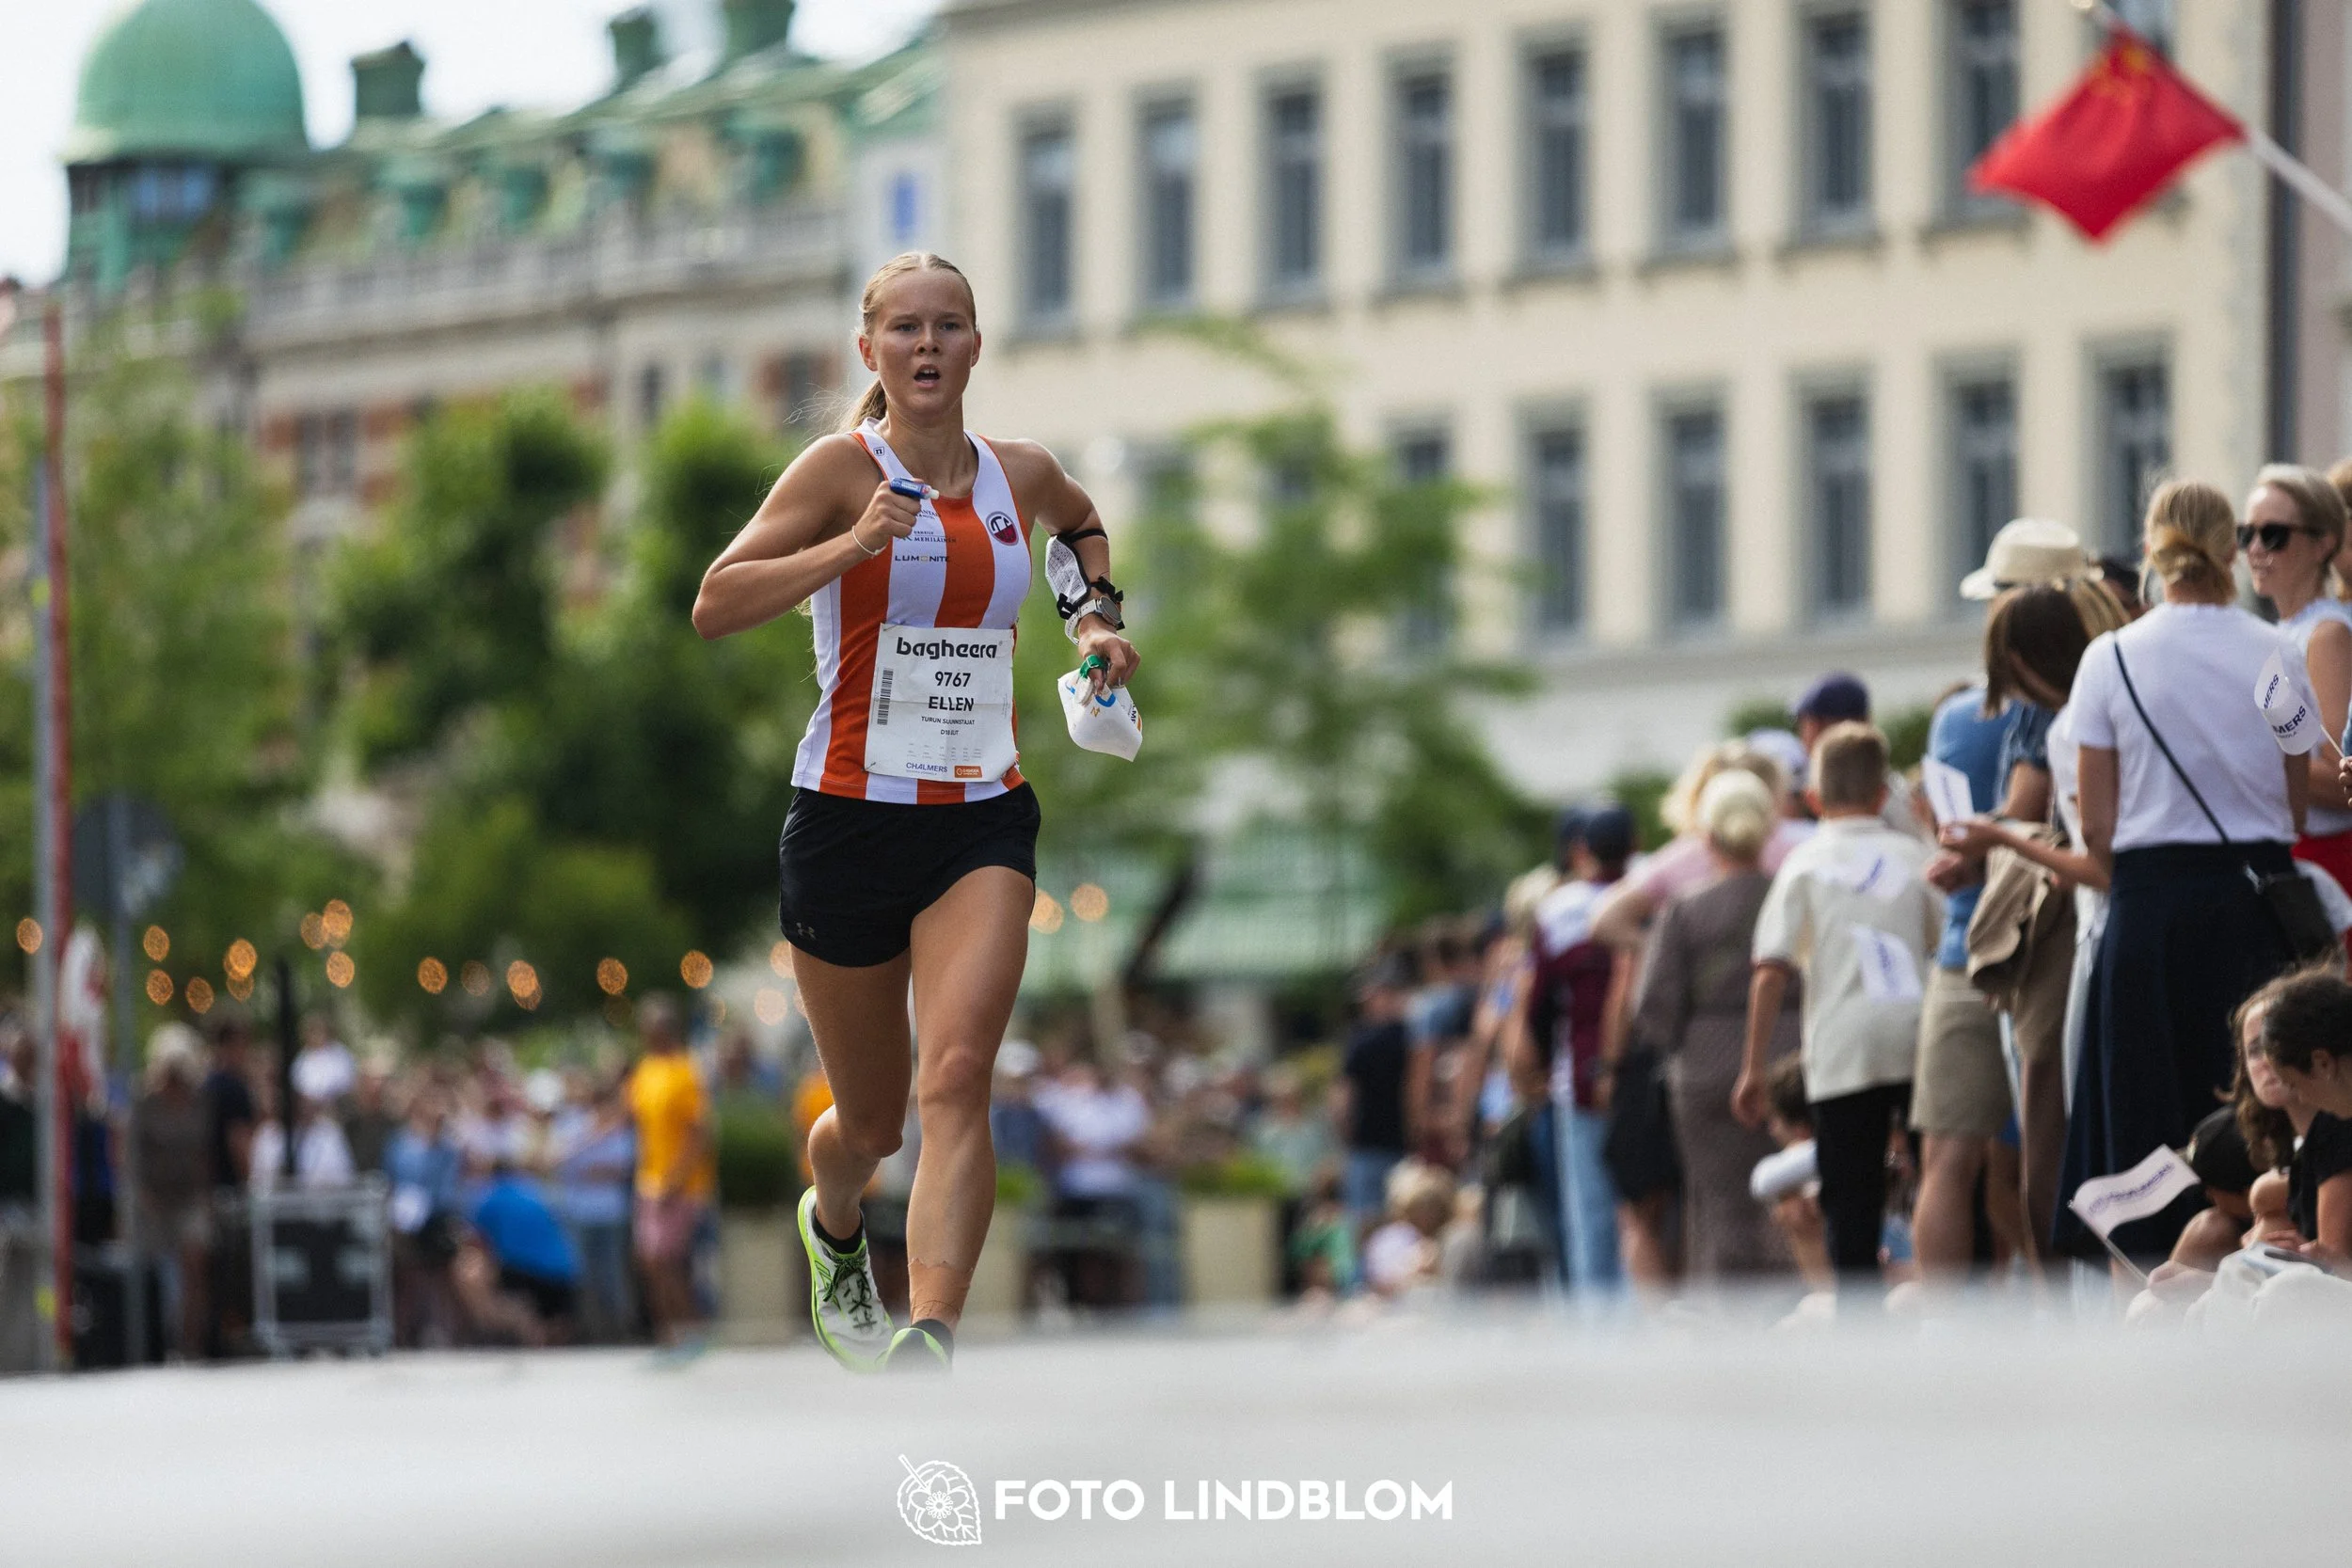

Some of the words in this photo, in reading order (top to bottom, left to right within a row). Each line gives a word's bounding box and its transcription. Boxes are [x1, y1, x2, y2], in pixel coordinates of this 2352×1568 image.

[896, 637, 998, 659] bagheera
[935, 671, 972, 688] 9767
[928, 696, 975, 712] ELLEN
[906, 762, 948, 773] CHALMERS
